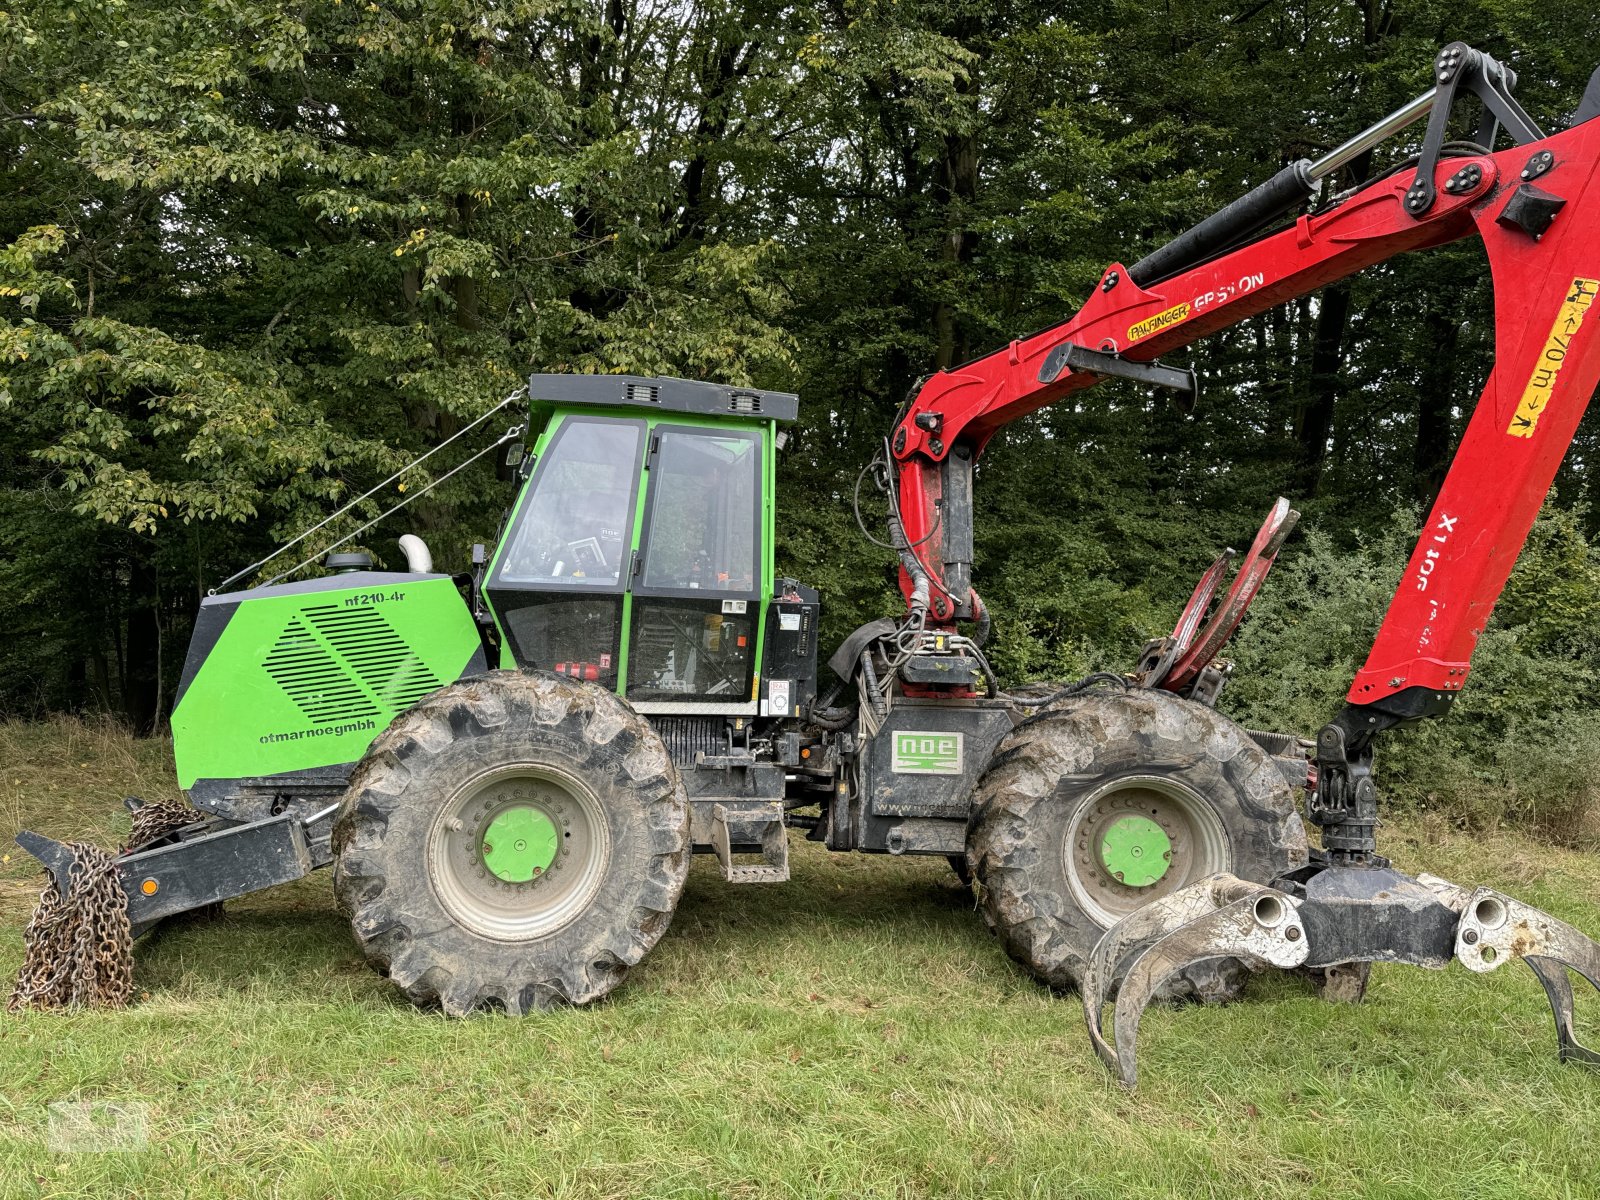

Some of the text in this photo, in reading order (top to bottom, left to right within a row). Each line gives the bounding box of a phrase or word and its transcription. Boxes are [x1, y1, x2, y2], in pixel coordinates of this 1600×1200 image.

[1532, 336, 1572, 388] 70 m
[902, 739, 953, 755] noe
